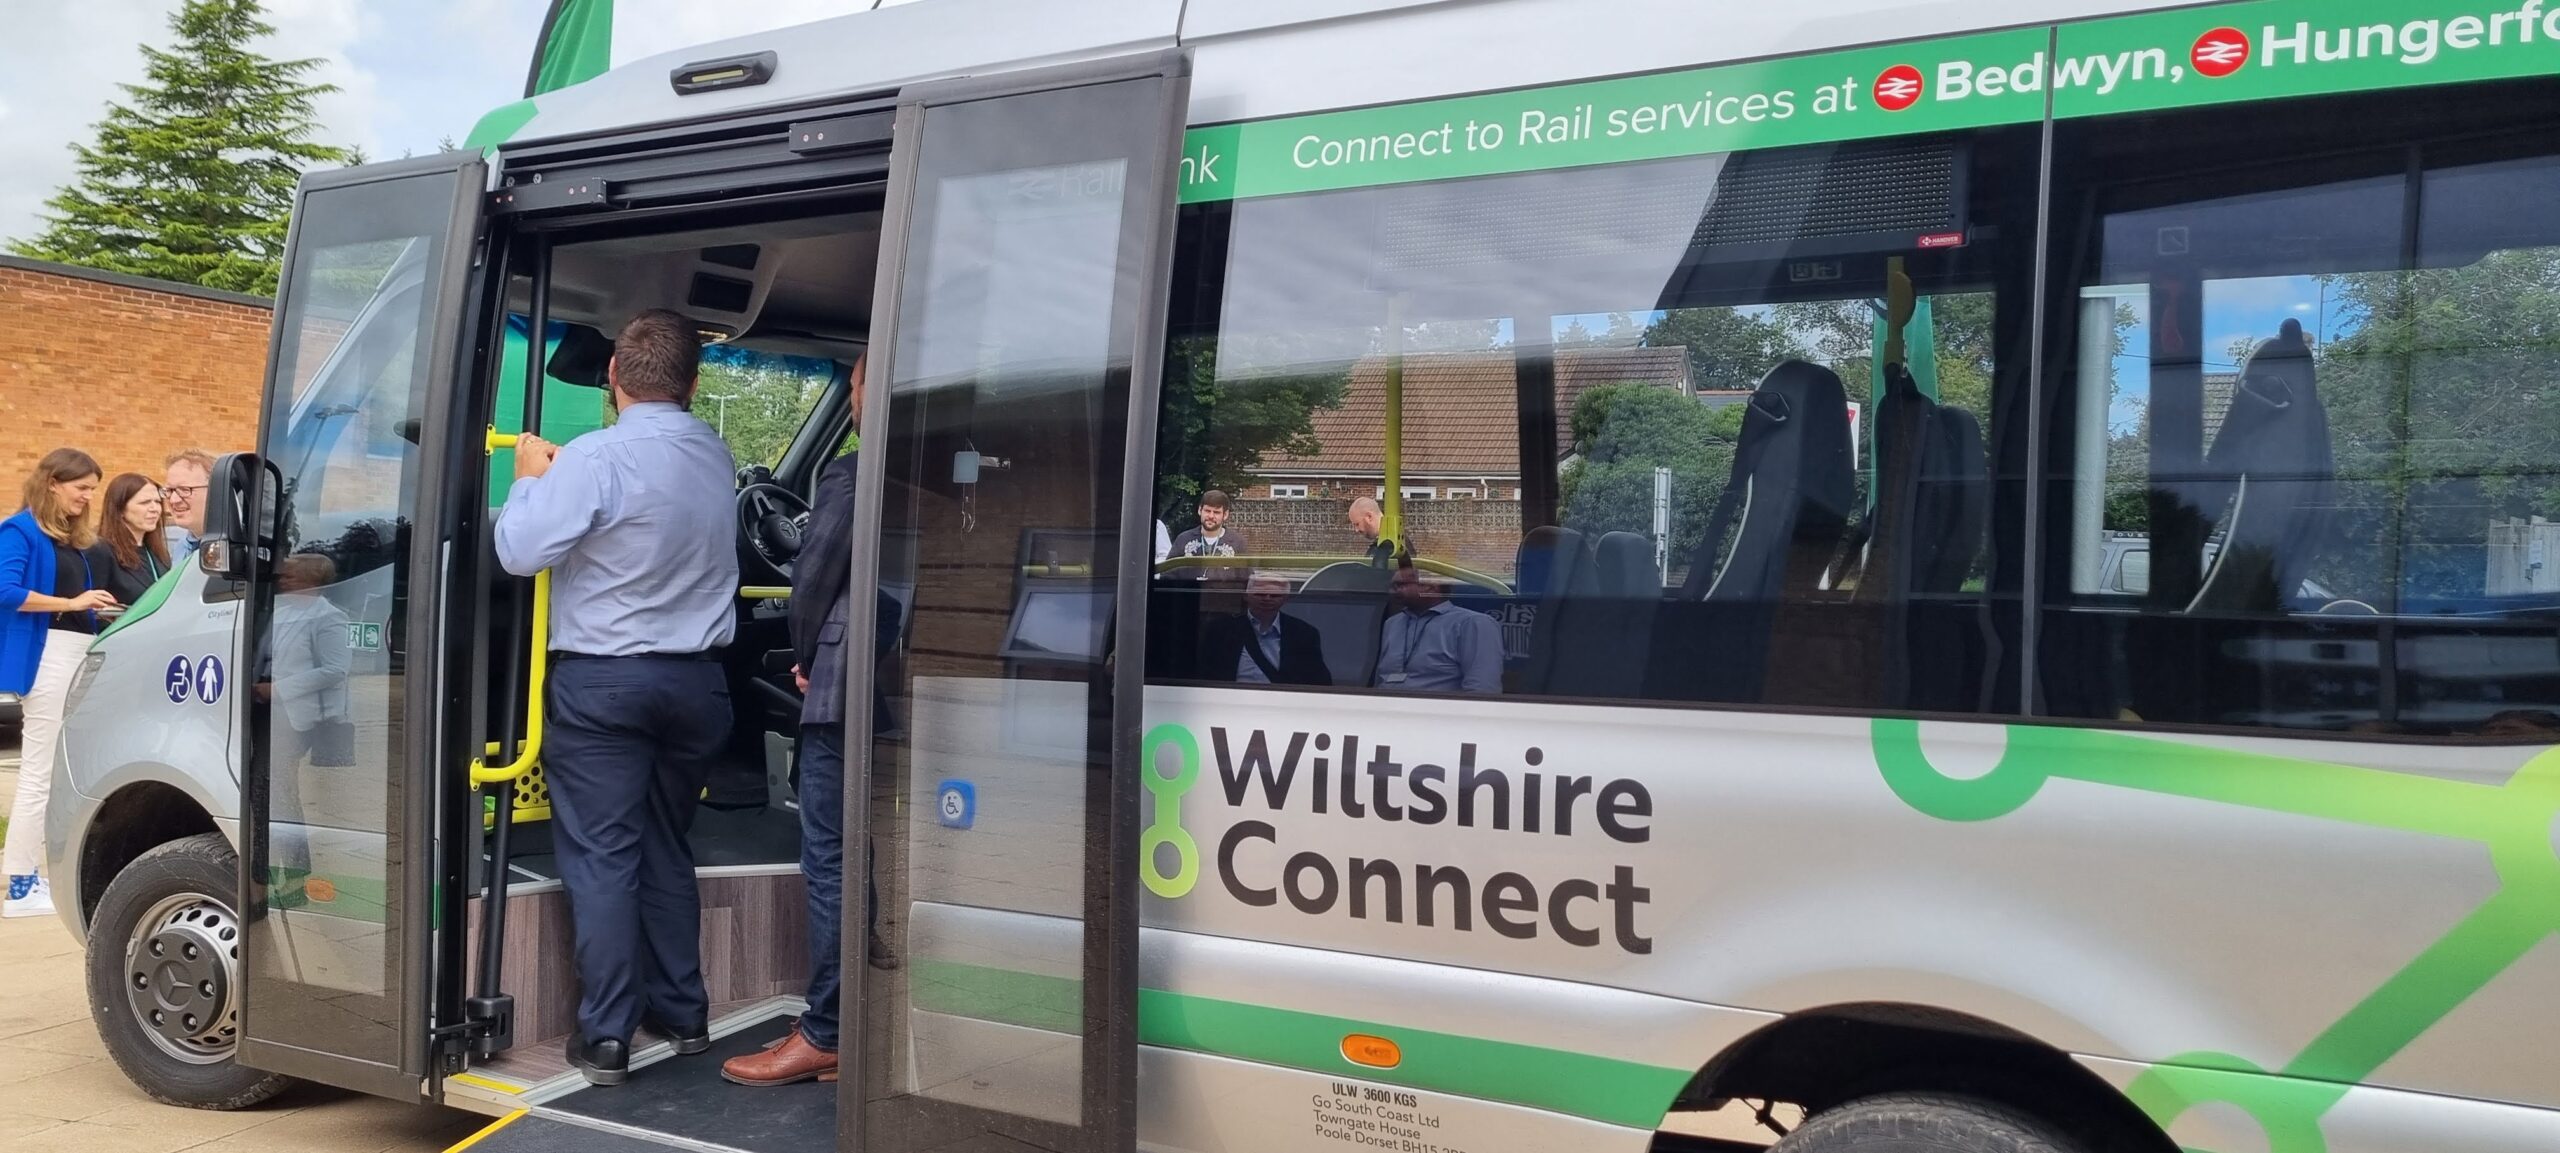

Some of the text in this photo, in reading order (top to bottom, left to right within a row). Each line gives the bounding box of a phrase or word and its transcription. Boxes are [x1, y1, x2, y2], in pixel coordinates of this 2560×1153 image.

[1293, 122, 1451, 171] Connect
[1465, 117, 1503, 151] to
[1518, 105, 1592, 147] Rail
[1605, 90, 1795, 140] services
[1812, 76, 1857, 114] at
[1936, 47, 2184, 101] Bedwyn,
[1210, 726, 1653, 844] Wiltshire
[1217, 819, 1653, 955] Connect
[1312, 1094, 1440, 1129] Go South Coast Ltd
[1332, 1082, 1418, 1108] ULW 3600 KGS
[1313, 1109, 1421, 1140] Towngate House
[1315, 1124, 1351, 1142] Poole
[1355, 1131, 1399, 1151] Dorset
